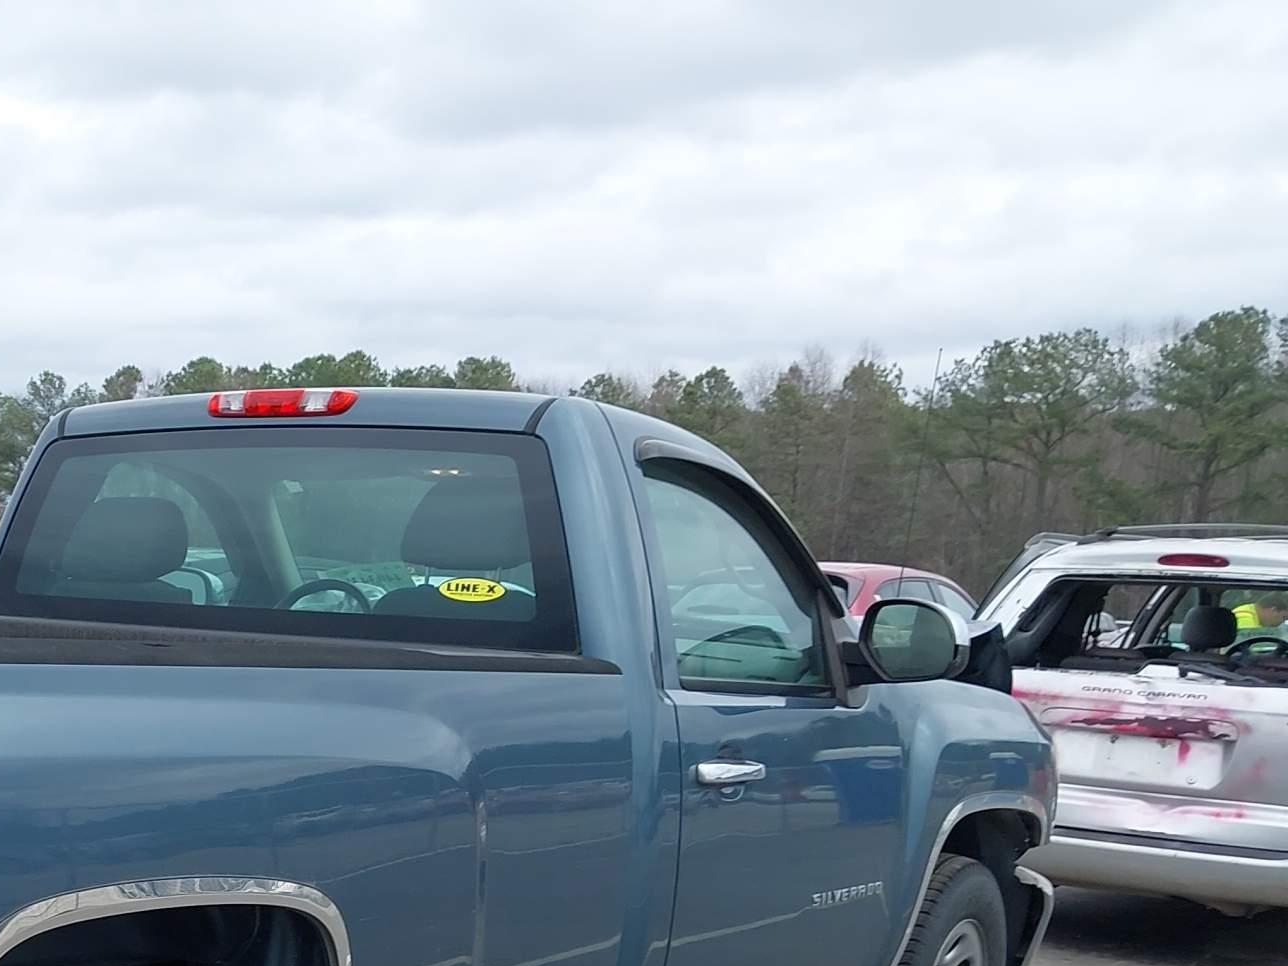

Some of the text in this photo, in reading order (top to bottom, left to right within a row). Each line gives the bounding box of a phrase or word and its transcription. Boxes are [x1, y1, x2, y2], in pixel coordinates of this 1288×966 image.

[446, 582, 498, 593] LINE-X
[1081, 684, 1209, 701] GRAND CARAVAN
[812, 880, 884, 907] SILVERADO
